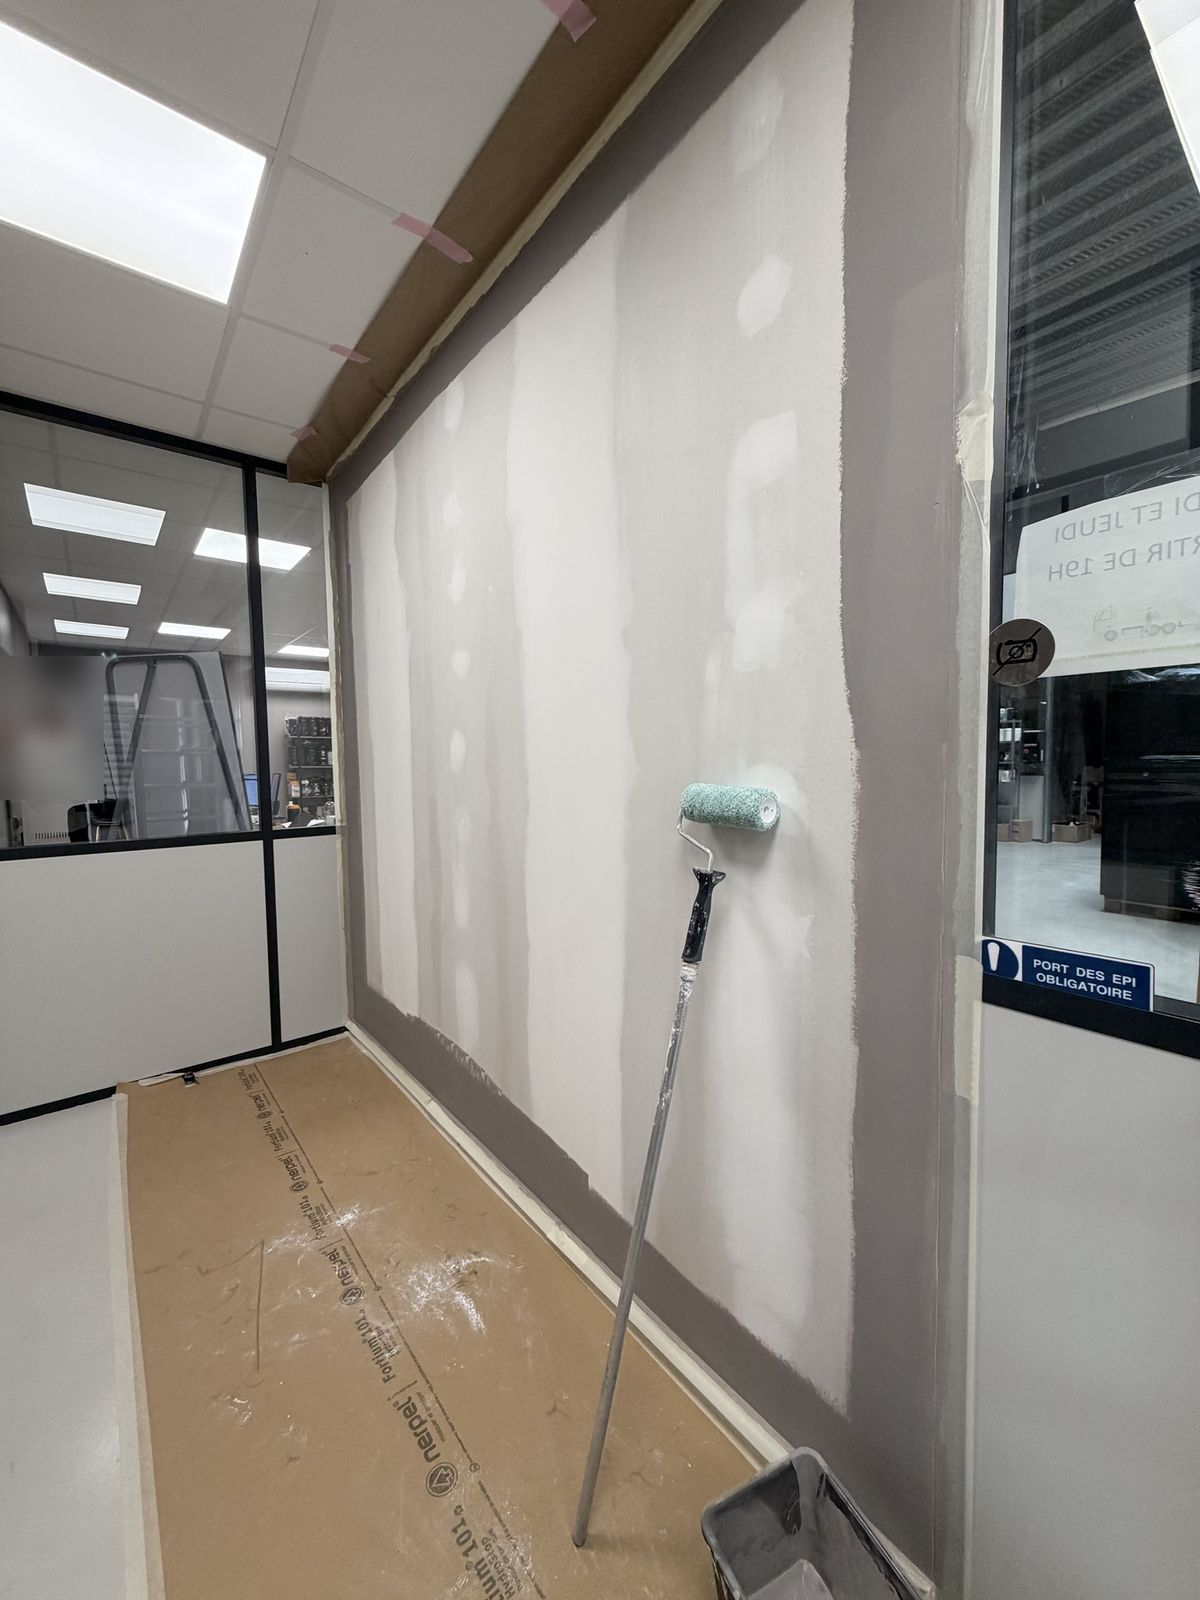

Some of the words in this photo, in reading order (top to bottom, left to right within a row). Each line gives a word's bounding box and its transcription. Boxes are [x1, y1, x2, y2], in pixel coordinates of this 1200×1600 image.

[1033, 958, 1070, 974] PORT
[1076, 967, 1105, 981] DES
[1112, 974, 1136, 988] EPI
[1036, 972, 1133, 1001] OBLIGATOIRE
[281, 1155, 302, 1182] nerpel
[299, 1197, 312, 1213] 101
[355, 1315, 373, 1338] 101
[367, 1336, 396, 1384] Fortium
[396, 1396, 441, 1463] nerpel
[451, 1517, 478, 1557] 101
